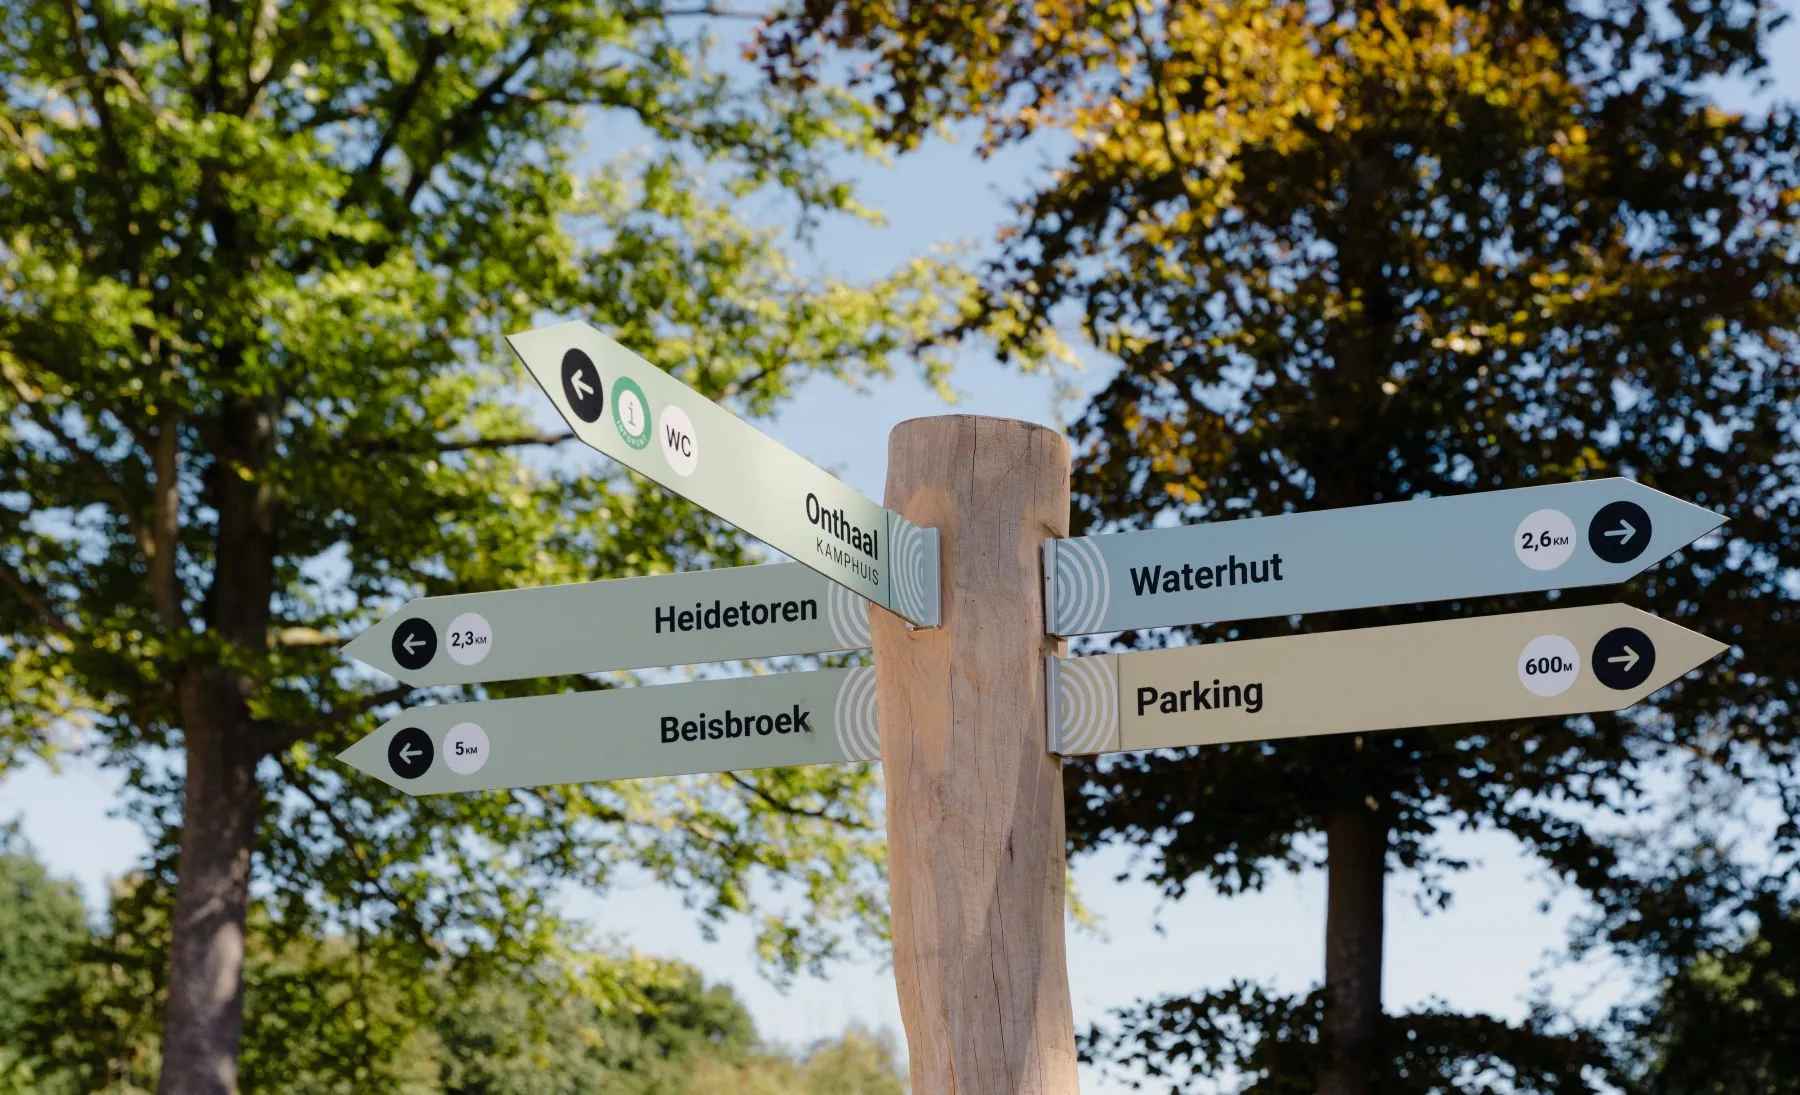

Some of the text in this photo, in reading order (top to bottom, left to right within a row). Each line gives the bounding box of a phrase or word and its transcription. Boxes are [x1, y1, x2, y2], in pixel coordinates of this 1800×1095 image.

[665, 424, 691, 457] WC
[805, 492, 878, 560] Onthaal
[816, 537, 879, 586] KAMPHUIS
[1130, 553, 1283, 596] Waterhut
[654, 598, 818, 634] Heidetoren
[1137, 678, 1263, 716] Parking
[660, 704, 811, 743] Beisbroek
